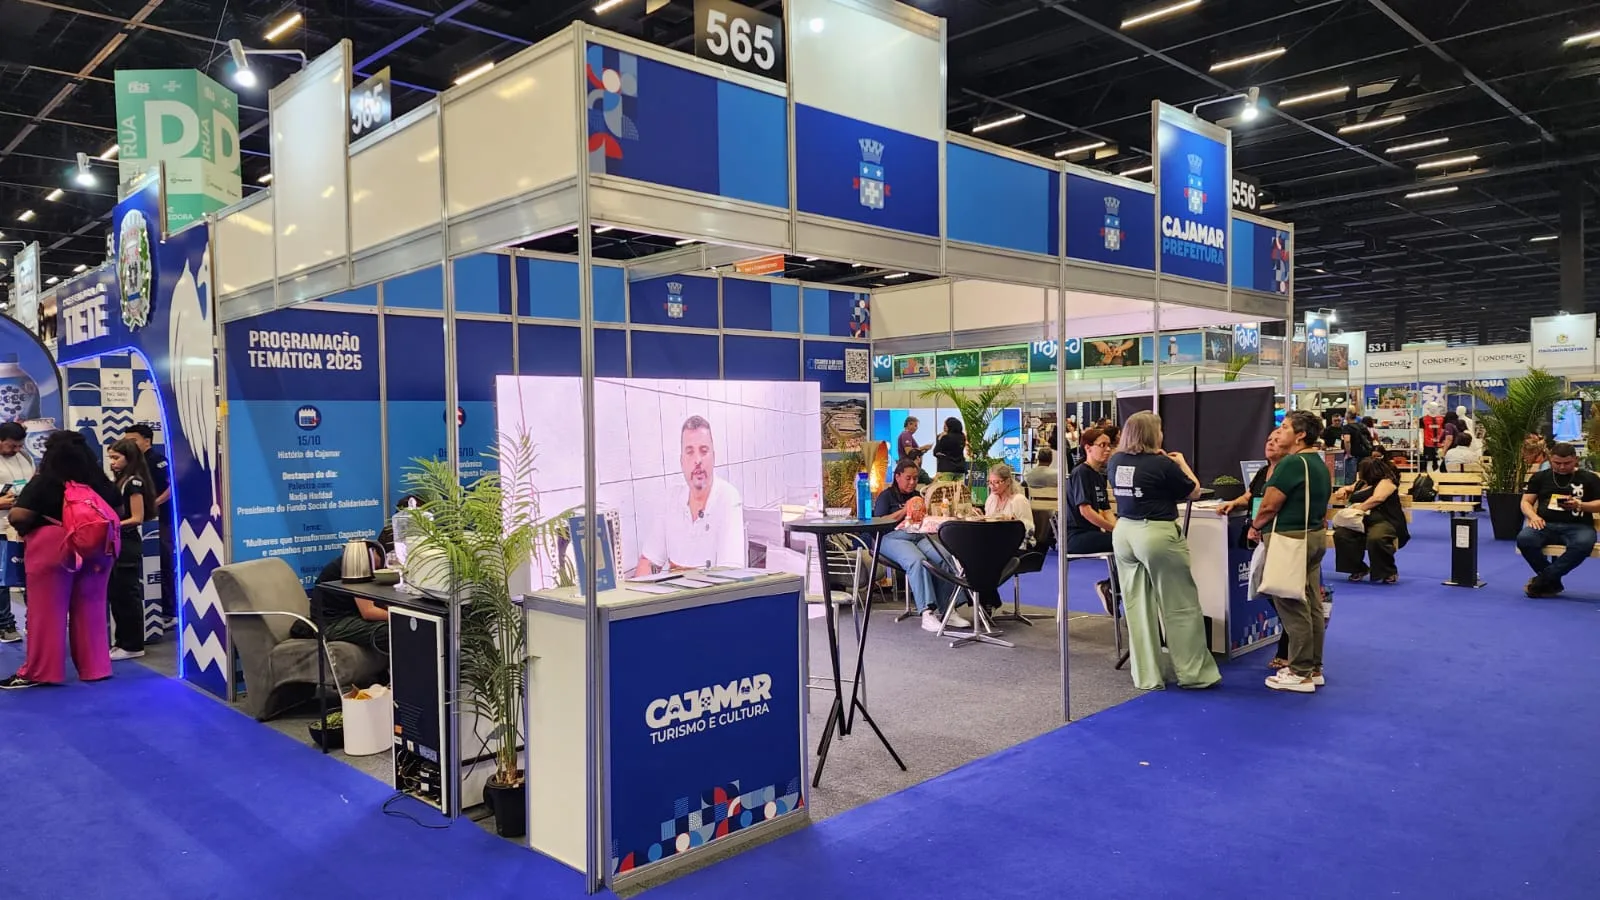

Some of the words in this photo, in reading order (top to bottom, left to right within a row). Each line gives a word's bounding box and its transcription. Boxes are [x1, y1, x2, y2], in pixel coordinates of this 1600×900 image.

[706, 9, 775, 70] 565
[121, 115, 138, 157] RUA
[144, 100, 199, 159] D
[202, 118, 211, 160] RUA
[213, 108, 240, 174] D
[1232, 178, 1256, 210] 556
[1162, 215, 1225, 249] CAJAMAR
[1162, 238, 1225, 266] PREFEITURA
[249, 331, 360, 355] PROGRAMAÇÃO
[1369, 343, 1387, 352] 531
[248, 348, 323, 369] TEMÁTICA
[326, 353, 362, 370] 2025
[297, 435, 321, 447] 15/10
[277, 450, 304, 459] História
[315, 450, 341, 459] Cajamar
[282, 471, 315, 481] Destaque
[315, 470, 325, 479] do
[288, 482, 316, 490] Palestra
[237, 506, 275, 515] Presidente
[276, 504, 286, 512] do
[286, 503, 307, 512] Fundo
[308, 502, 328, 510] Social
[328, 501, 337, 509] de
[338, 498, 379, 508] Solidariedade
[279, 537, 293, 547] que
[338, 529, 376, 540] Capacitação
[268, 547, 302, 556] caminhos
[302, 546, 318, 555] para
[645, 673, 772, 729] CAJAMAR
[650, 719, 706, 745] TURISMO
[709, 716, 716, 729] E
[719, 702, 770, 726] CULTURA
